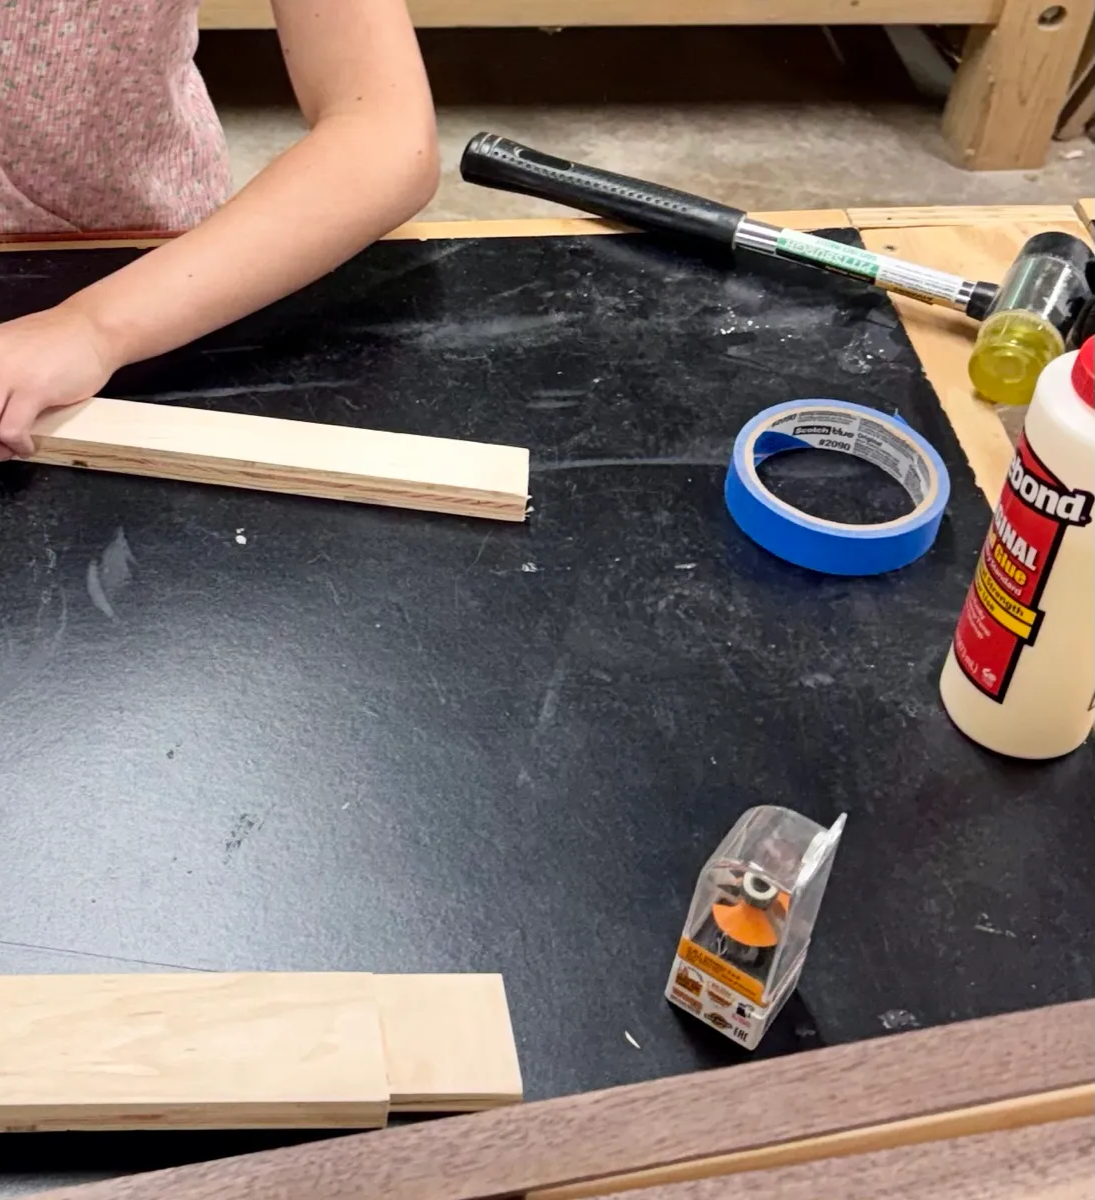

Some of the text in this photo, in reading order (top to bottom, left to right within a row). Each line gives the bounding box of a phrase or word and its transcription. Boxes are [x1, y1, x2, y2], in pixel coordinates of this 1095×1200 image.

[795, 426, 830, 436] Scotch
[818, 438, 852, 451] #2090
[994, 544, 1027, 586] Glue
